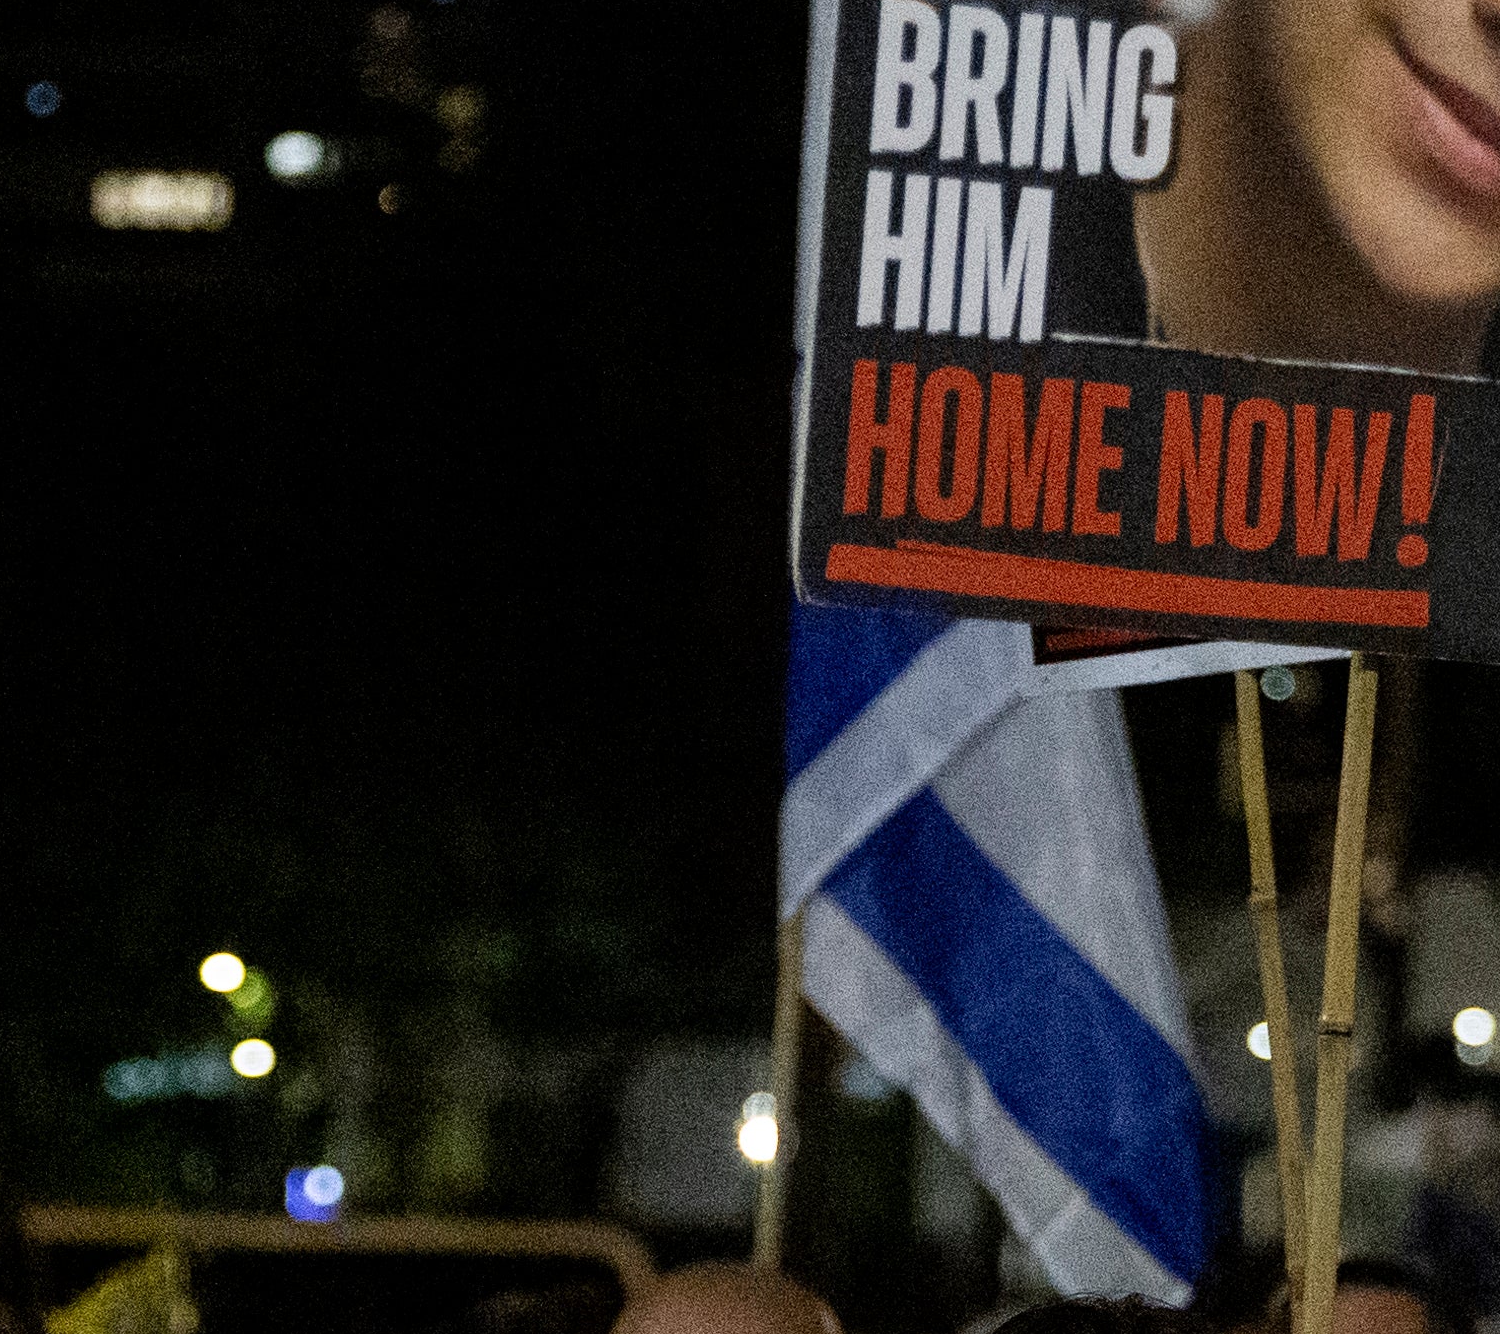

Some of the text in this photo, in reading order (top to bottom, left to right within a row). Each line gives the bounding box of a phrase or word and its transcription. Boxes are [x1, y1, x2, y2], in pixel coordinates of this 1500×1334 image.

[856, 169, 1053, 343] HIM
[843, 359, 1436, 567] HOME NOW!
